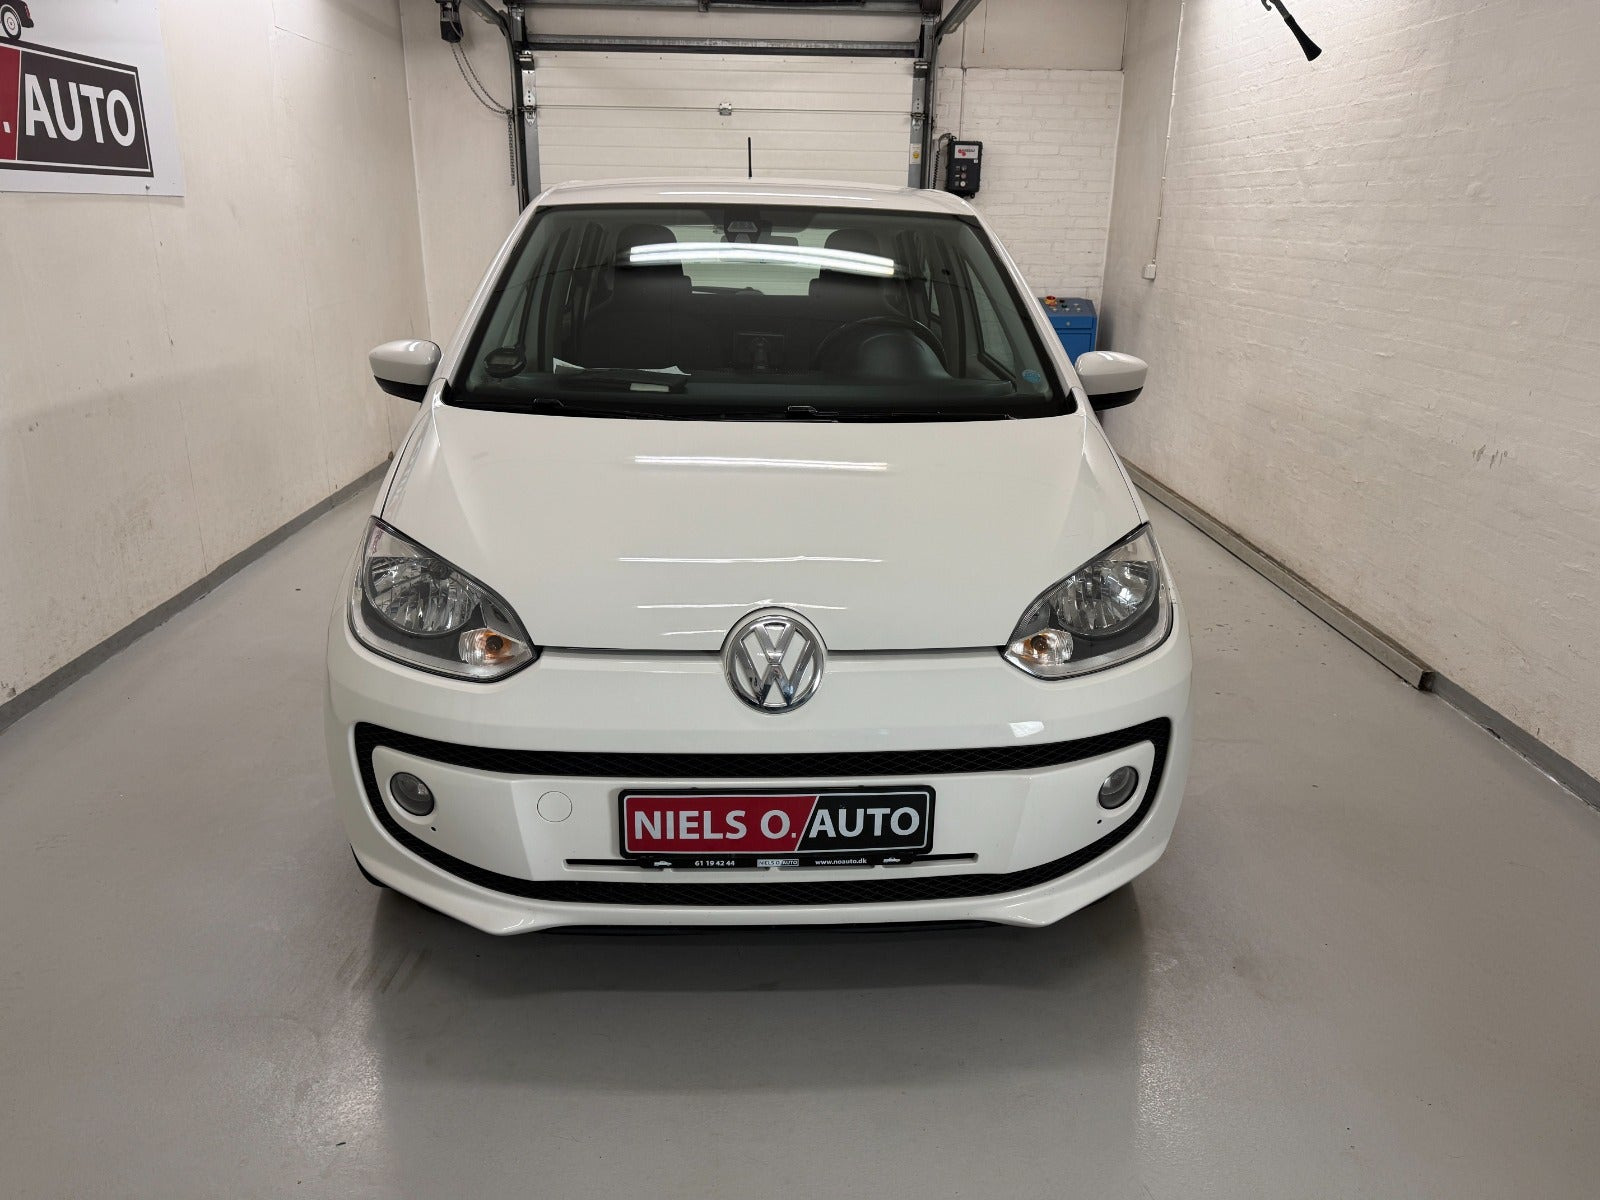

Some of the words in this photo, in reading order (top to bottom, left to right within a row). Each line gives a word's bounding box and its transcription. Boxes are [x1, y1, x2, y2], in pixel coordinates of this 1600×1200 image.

[24, 73, 136, 147] AUTO
[634, 810, 747, 840] NIELS
[760, 809, 797, 839] O.
[808, 806, 920, 838] AUTO
